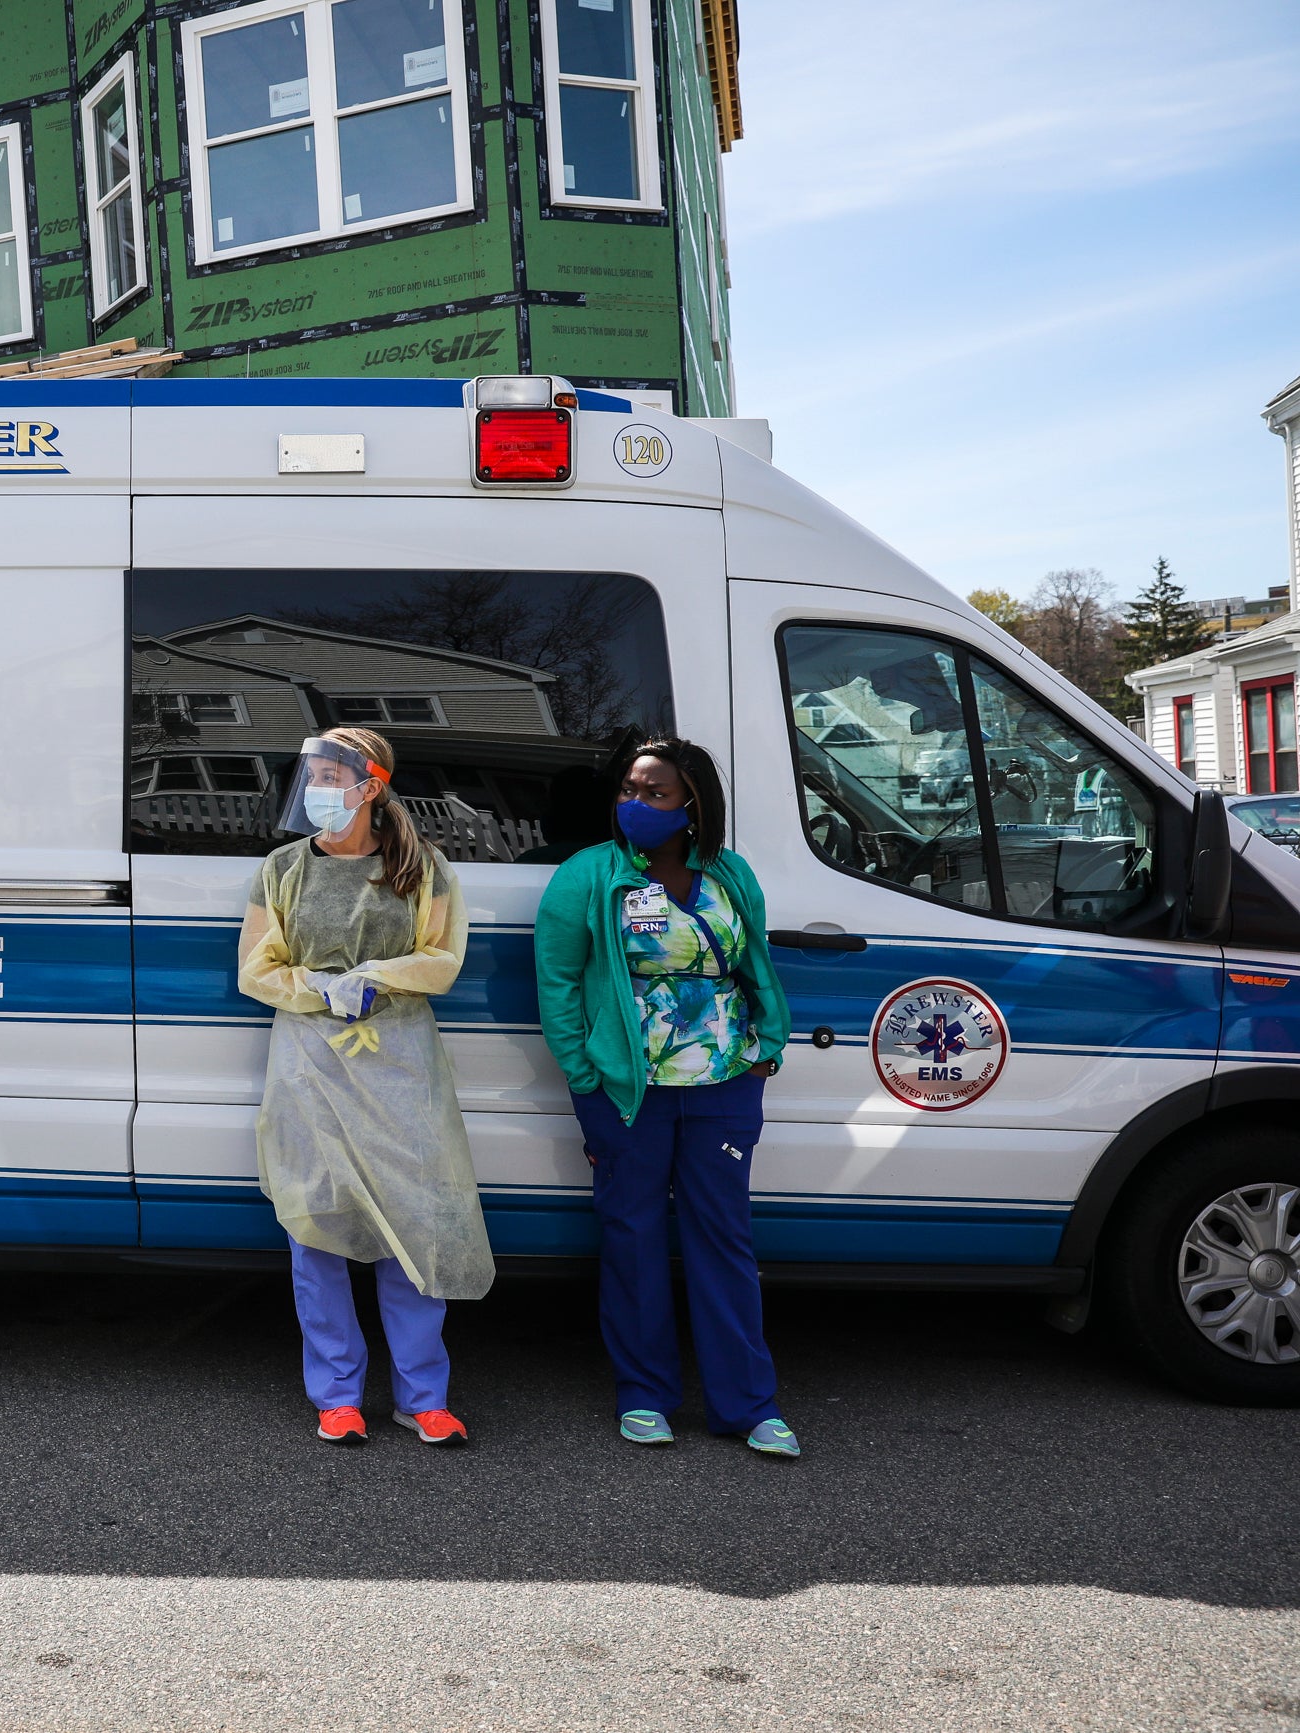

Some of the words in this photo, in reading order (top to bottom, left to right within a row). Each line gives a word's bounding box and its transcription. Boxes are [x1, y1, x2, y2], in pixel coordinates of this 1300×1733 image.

[387, 284, 406, 296] ROOF
[407, 281, 422, 291] AND
[423, 278, 442, 289] WALL
[443, 269, 486, 285] SHEATHING
[185, 294, 314, 332] ZIPsystem
[365, 328, 507, 367] ZIPsystem
[274, 364, 293, 375] ROOF
[621, 435, 664, 465] 120
[640, 922, 659, 931] RN
[885, 992, 994, 1039] BREWSTER
[888, 1069, 922, 1099] TRUSTED
[923, 1093, 951, 1102] NAME
[952, 1079, 980, 1099] SINCE
[978, 1061, 995, 1082] 1906
[918, 1067, 963, 1081] EMS
